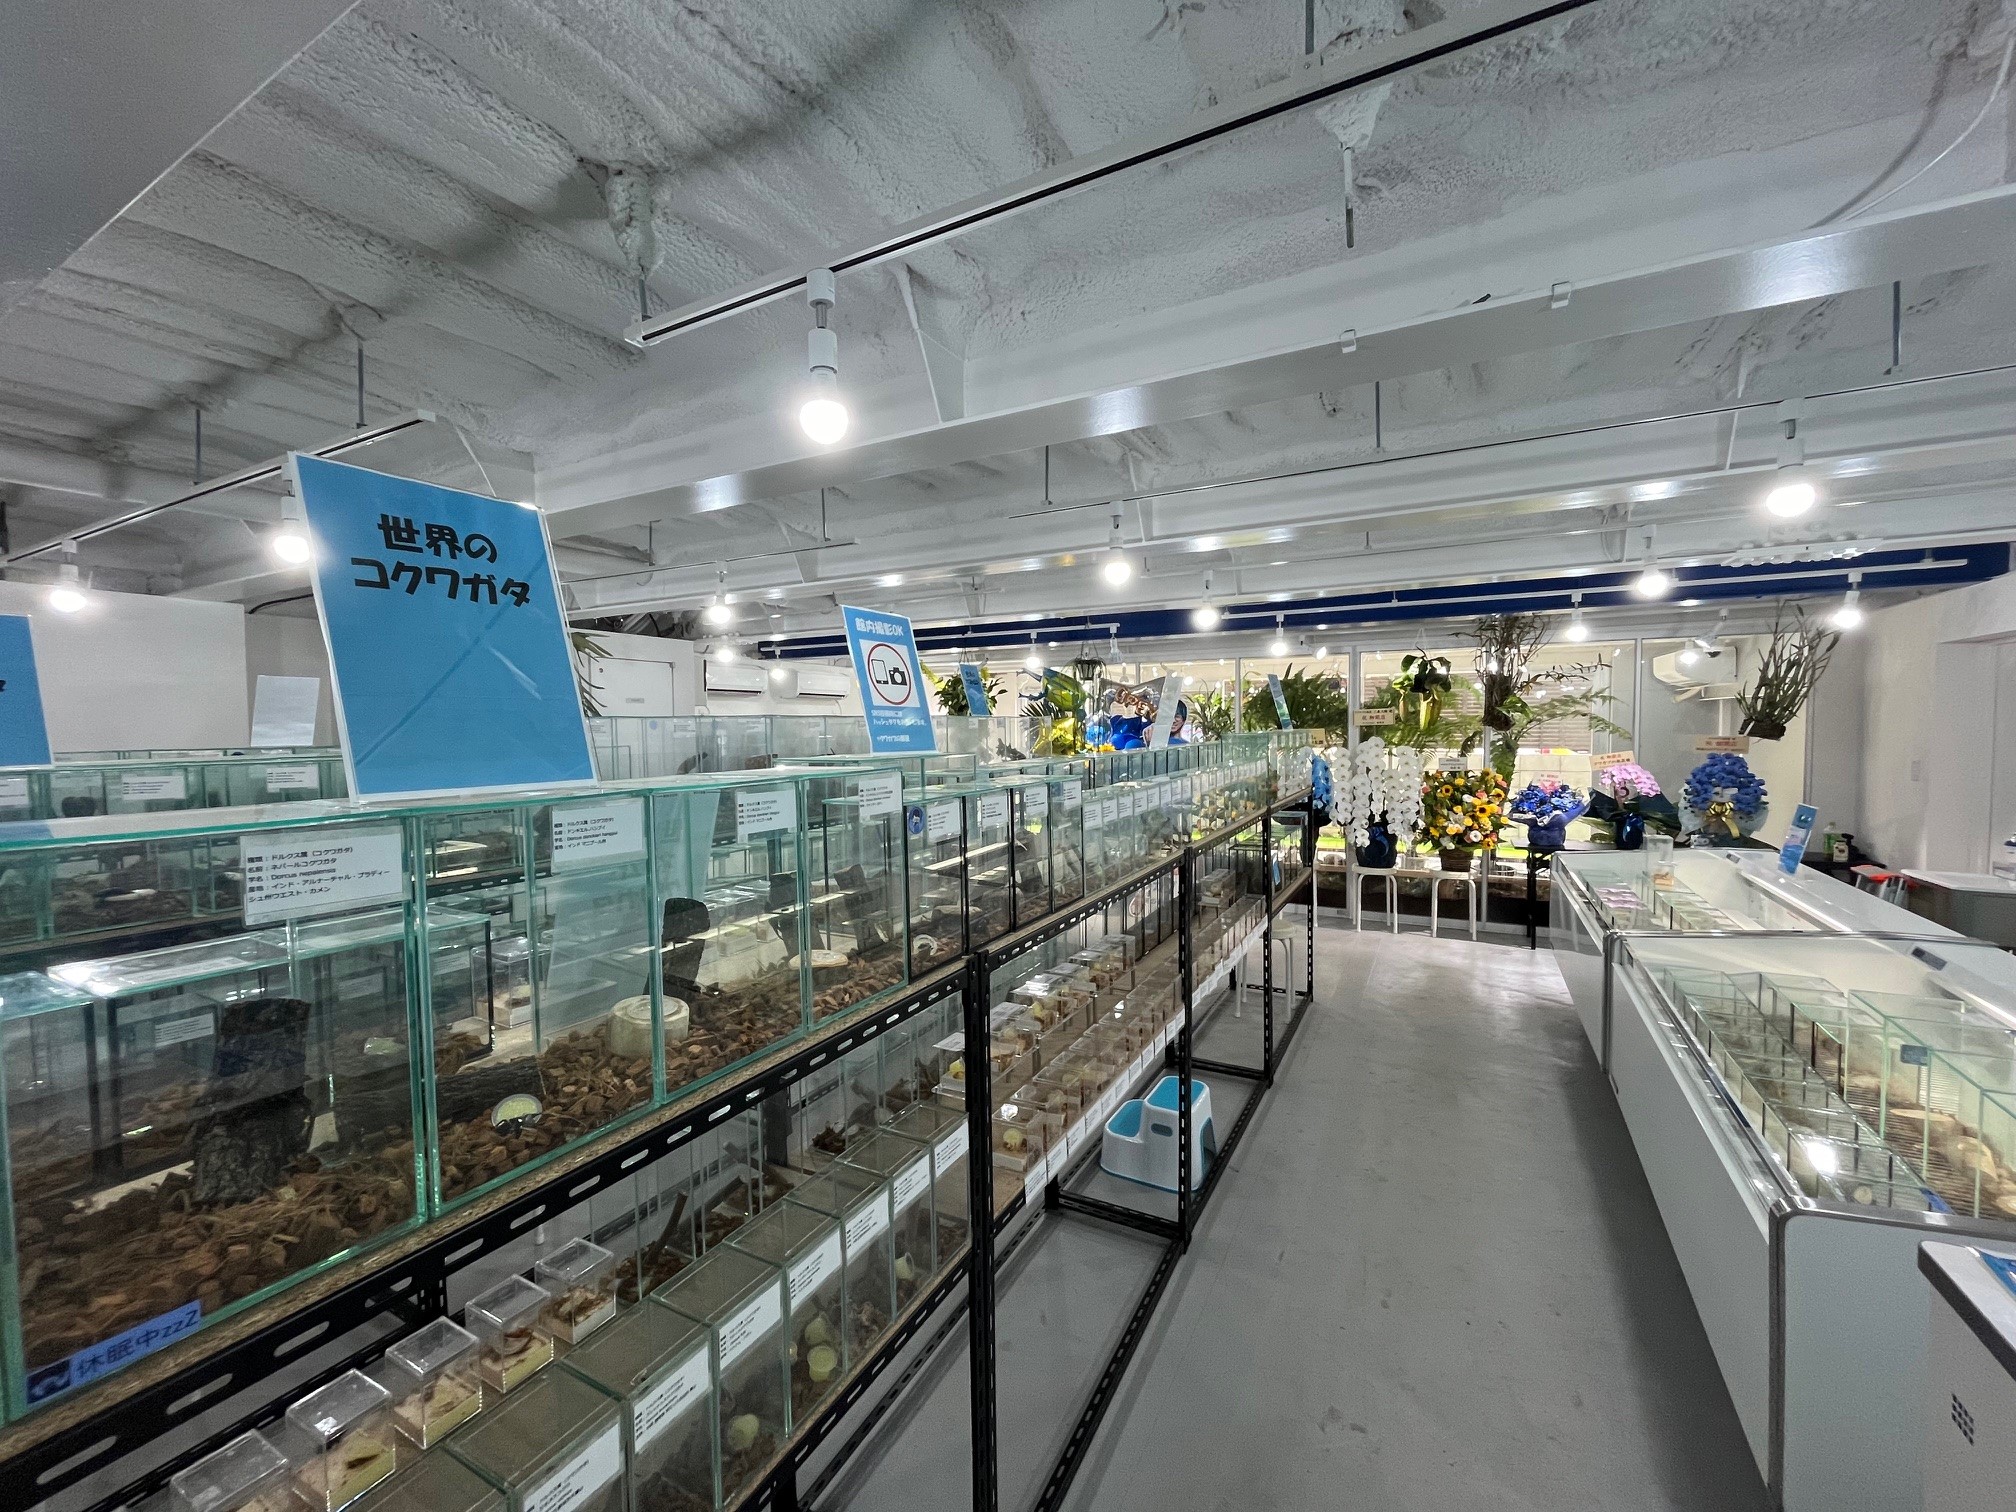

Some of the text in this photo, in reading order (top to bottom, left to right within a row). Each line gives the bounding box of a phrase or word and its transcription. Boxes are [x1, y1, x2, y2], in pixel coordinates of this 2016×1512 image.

[377, 513, 498, 564] 世界の
[350, 556, 531, 608] コクワガタ
